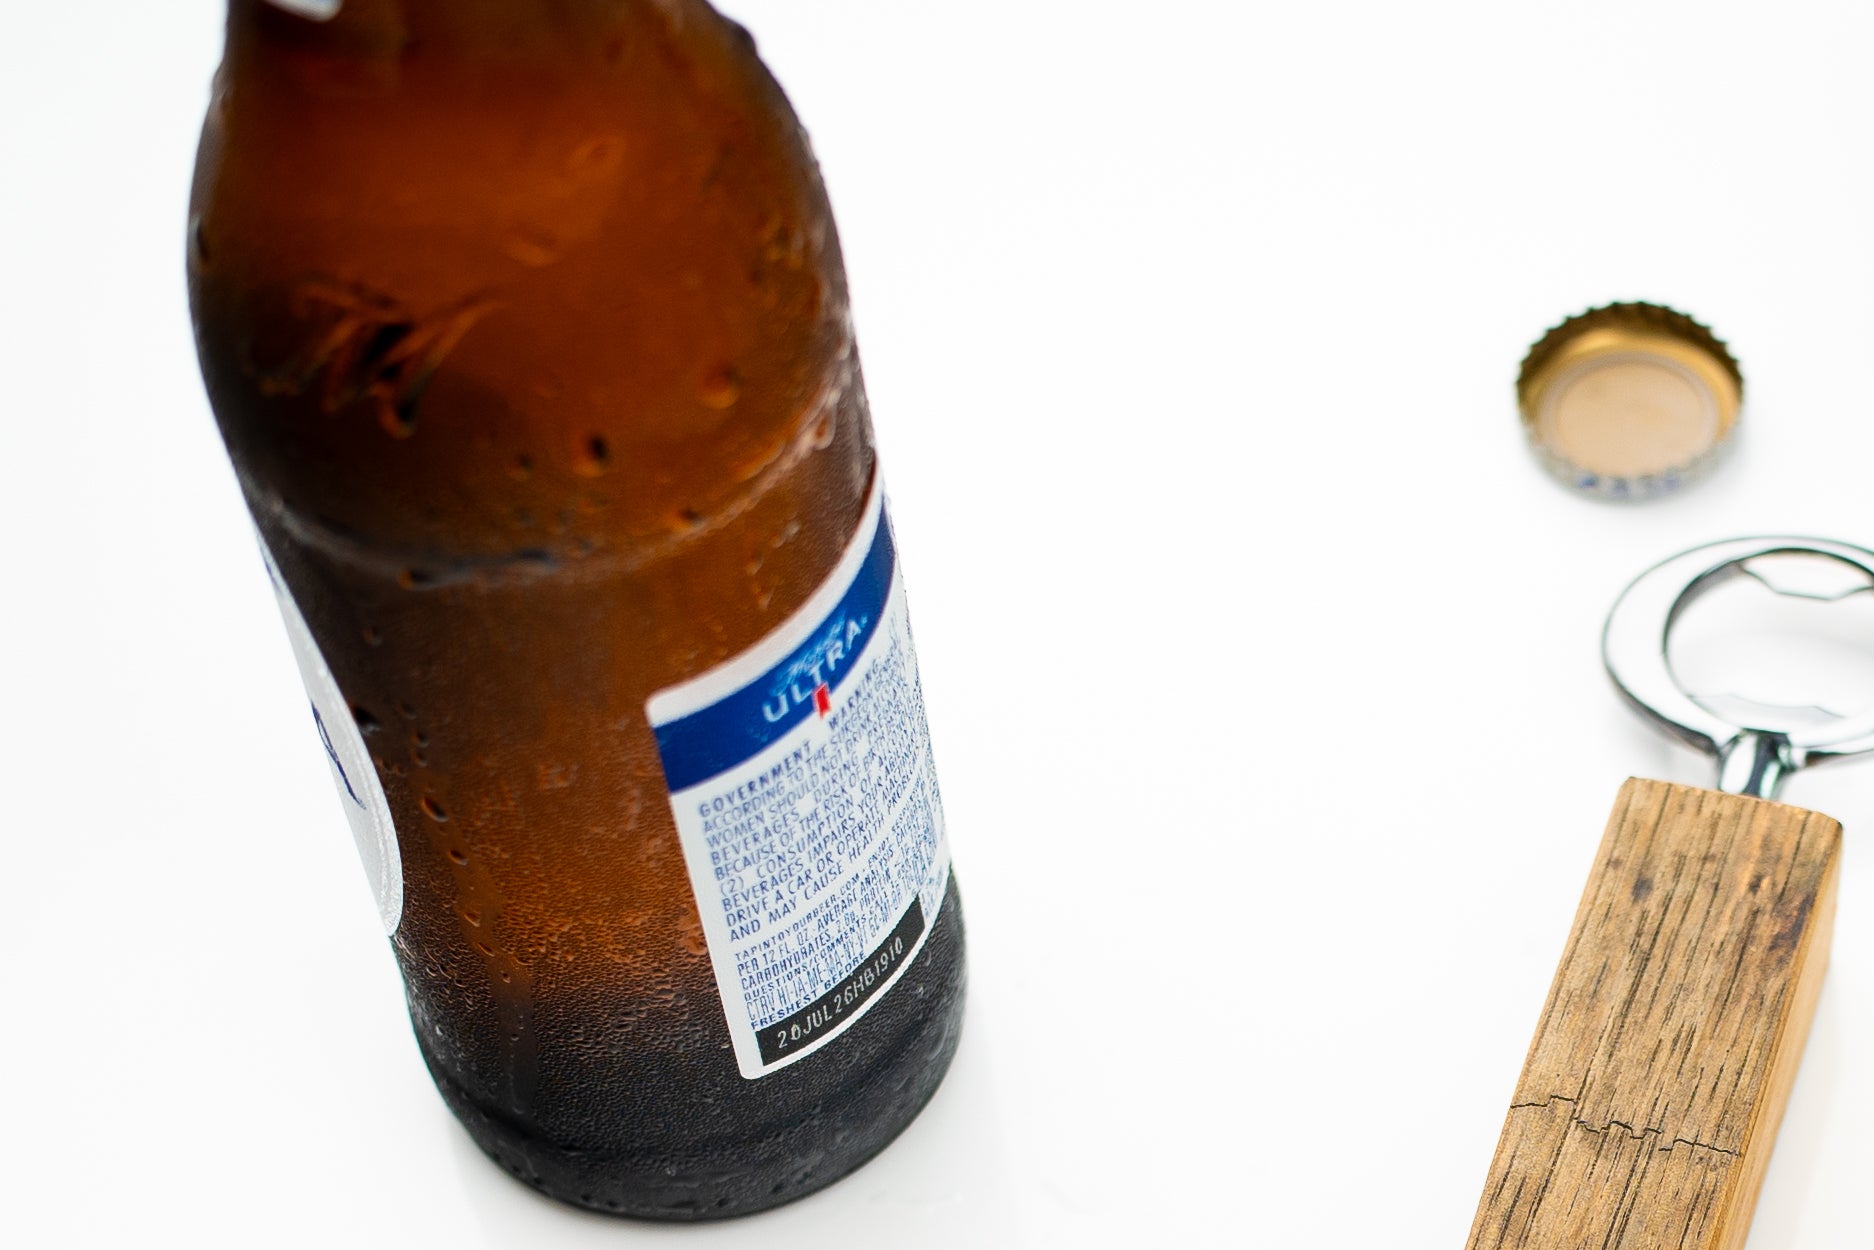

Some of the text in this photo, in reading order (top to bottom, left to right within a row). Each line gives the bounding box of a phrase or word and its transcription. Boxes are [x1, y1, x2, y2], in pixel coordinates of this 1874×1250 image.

[762, 619, 862, 722] ULTRA
[699, 740, 811, 818] GOVERNMENT
[704, 780, 785, 833] ACCORDING
[787, 767, 804, 787] TO
[806, 744, 828, 773] THE
[706, 811, 765, 848] WOMEN
[769, 772, 819, 820] SHOULD
[710, 806, 800, 866] BEVERAGES
[814, 751, 858, 804] DURING
[714, 839, 777, 881] BECAUSE
[781, 826, 797, 847] OF
[800, 806, 821, 833] THE
[720, 876, 745, 897] (2)
[756, 794, 853, 879] CONSUMPTION
[861, 769, 872, 794] OF
[722, 857, 804, 912] BEVERAGES
[808, 811, 856, 863] IMPAIRS
[726, 896, 769, 928] DRIVE
[775, 889, 785, 903] A
[787, 868, 813, 895] CAR
[817, 850, 834, 874] OR
[837, 799, 879, 856] OPERATE
[730, 918, 761, 942] AND
[768, 895, 798, 925] MAY
[804, 862, 844, 901] CAUSE
[849, 812, 884, 863] HEALTH
[737, 956, 760, 977] PER
[763, 948, 776, 966] 12
[750, 949, 866, 1031] FRESHEST BEFORE
